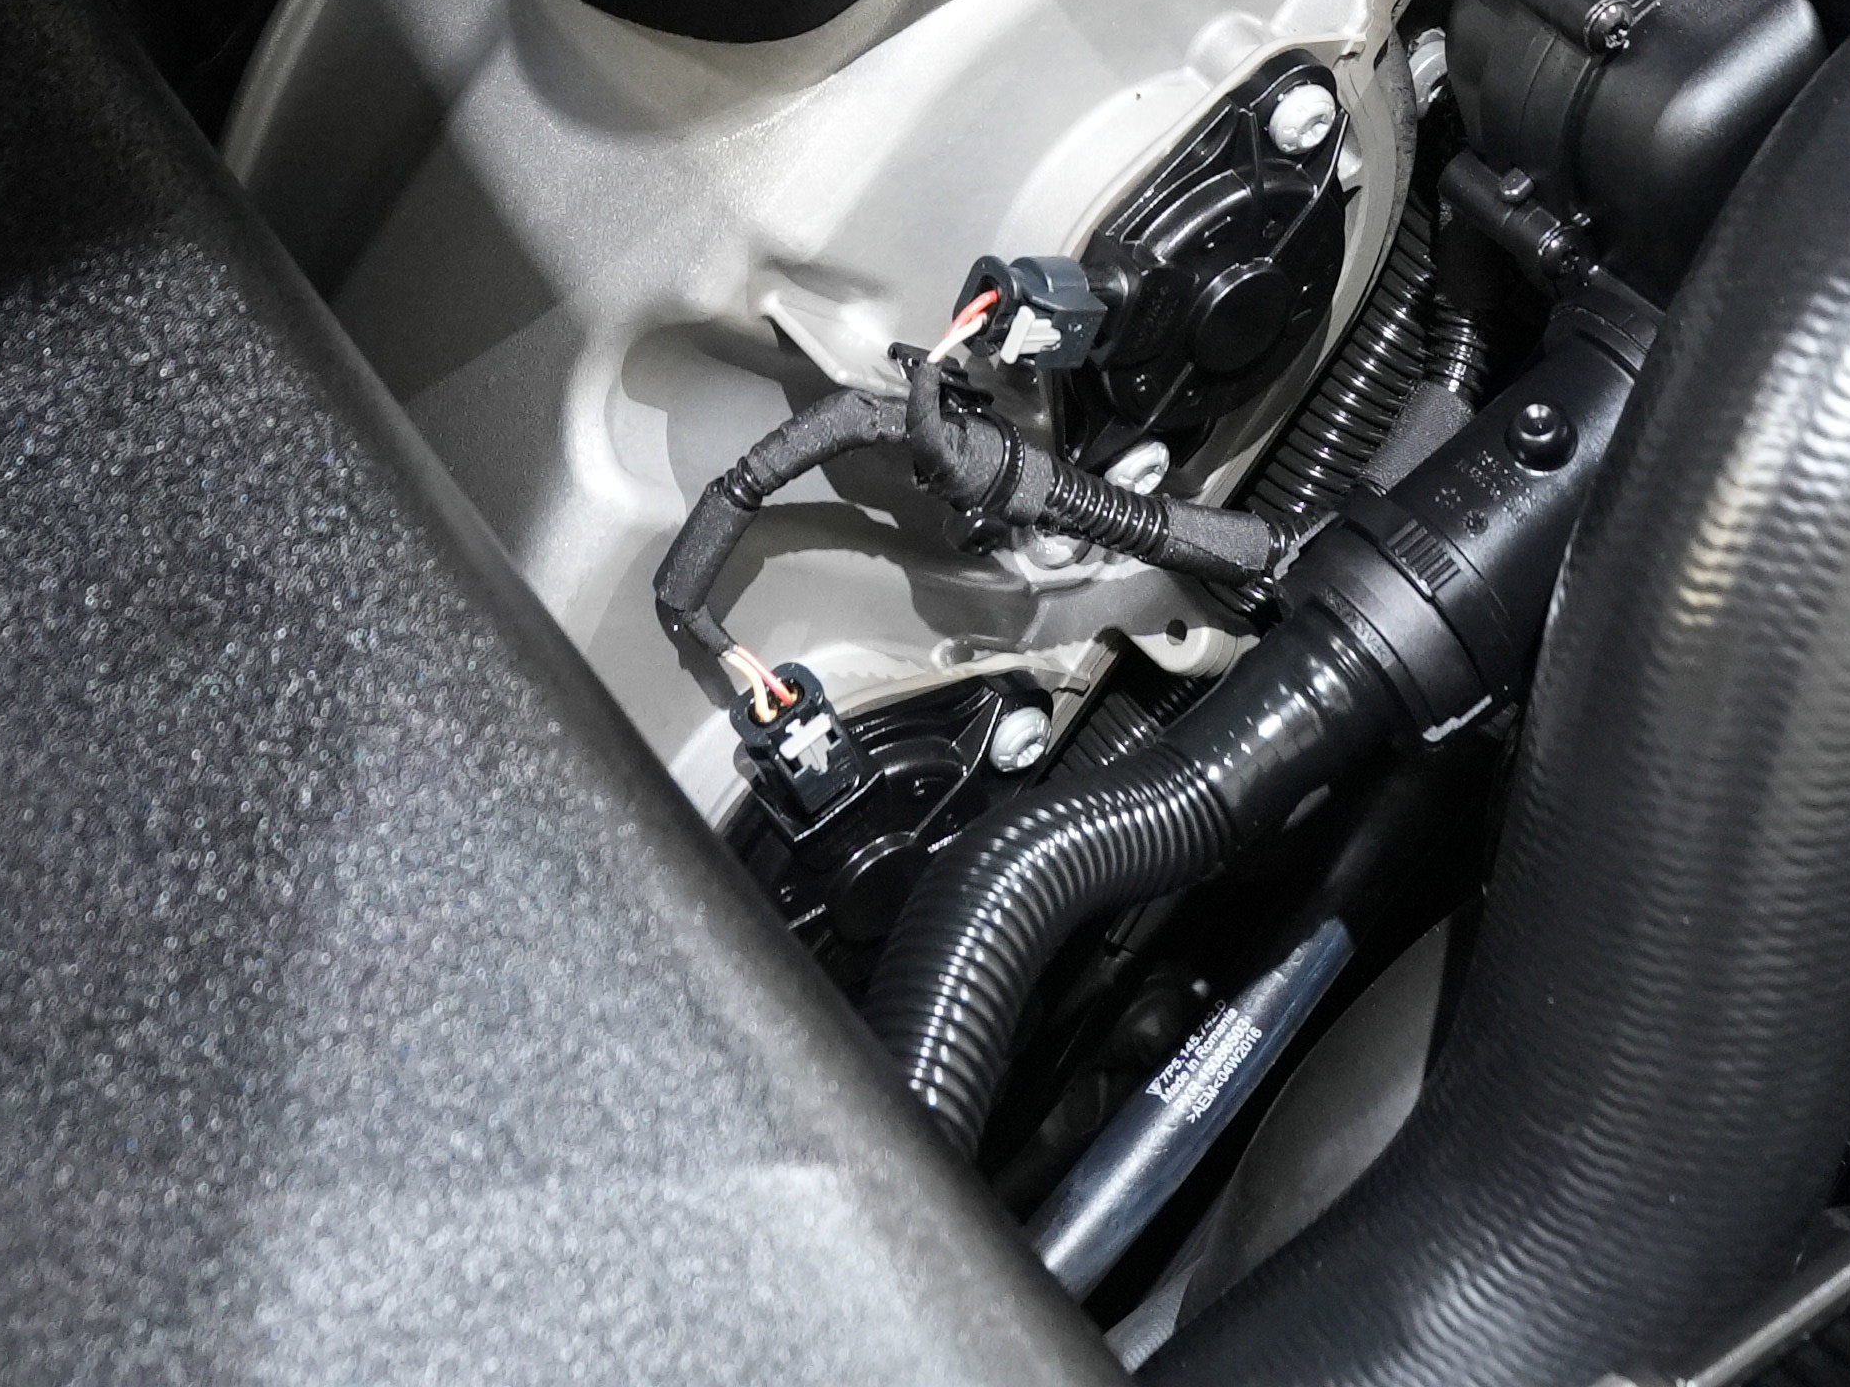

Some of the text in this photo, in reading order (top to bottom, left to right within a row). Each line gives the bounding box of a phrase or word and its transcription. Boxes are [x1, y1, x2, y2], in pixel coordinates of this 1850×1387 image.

[1159, 1007, 1239, 1104] Made in Romania
